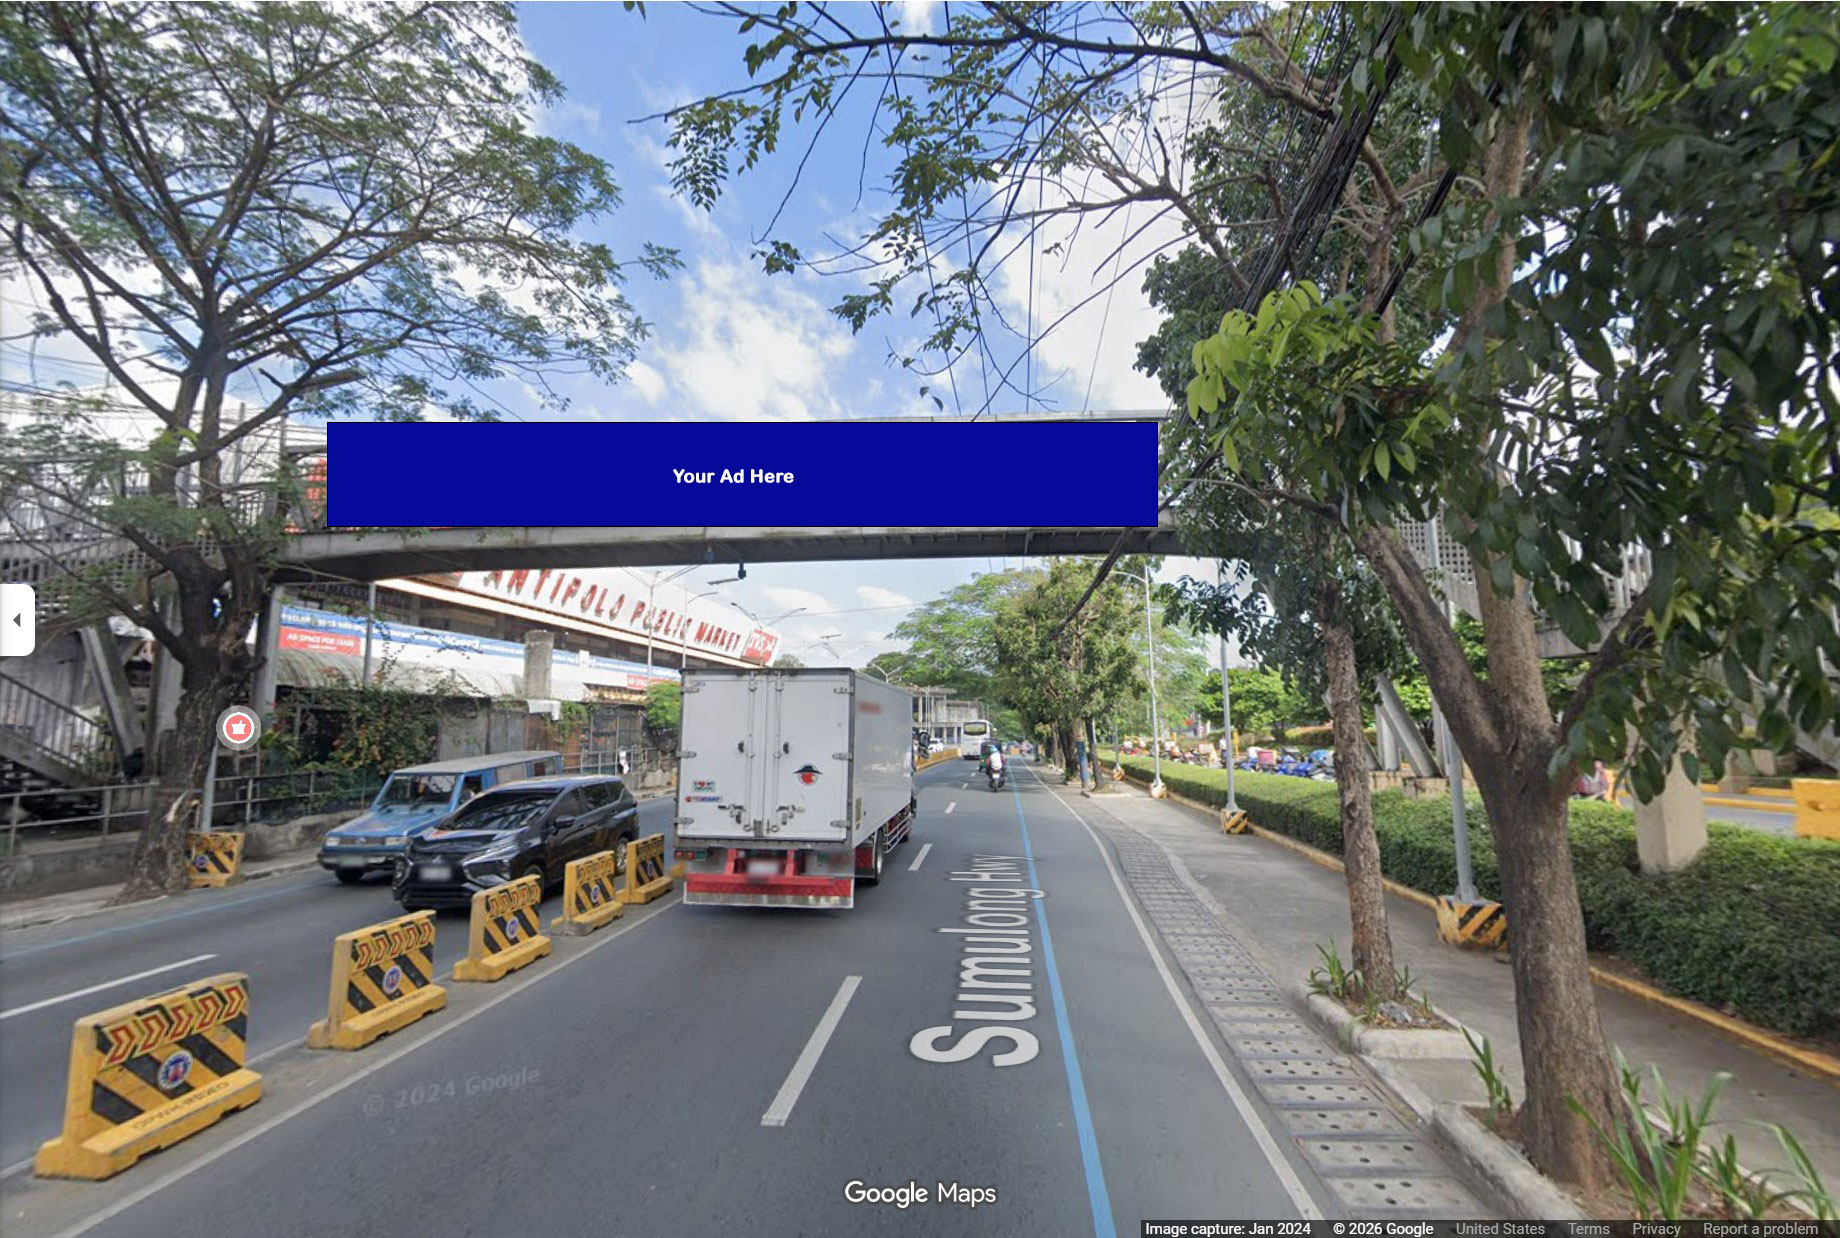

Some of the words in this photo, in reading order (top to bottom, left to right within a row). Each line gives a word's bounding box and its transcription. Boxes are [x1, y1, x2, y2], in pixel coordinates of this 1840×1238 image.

[482, 569, 626, 621] ANTIPOLO
[629, 600, 693, 640] PUBLIC
[694, 621, 742, 653] MARKET
[321, 637, 336, 645] FOR
